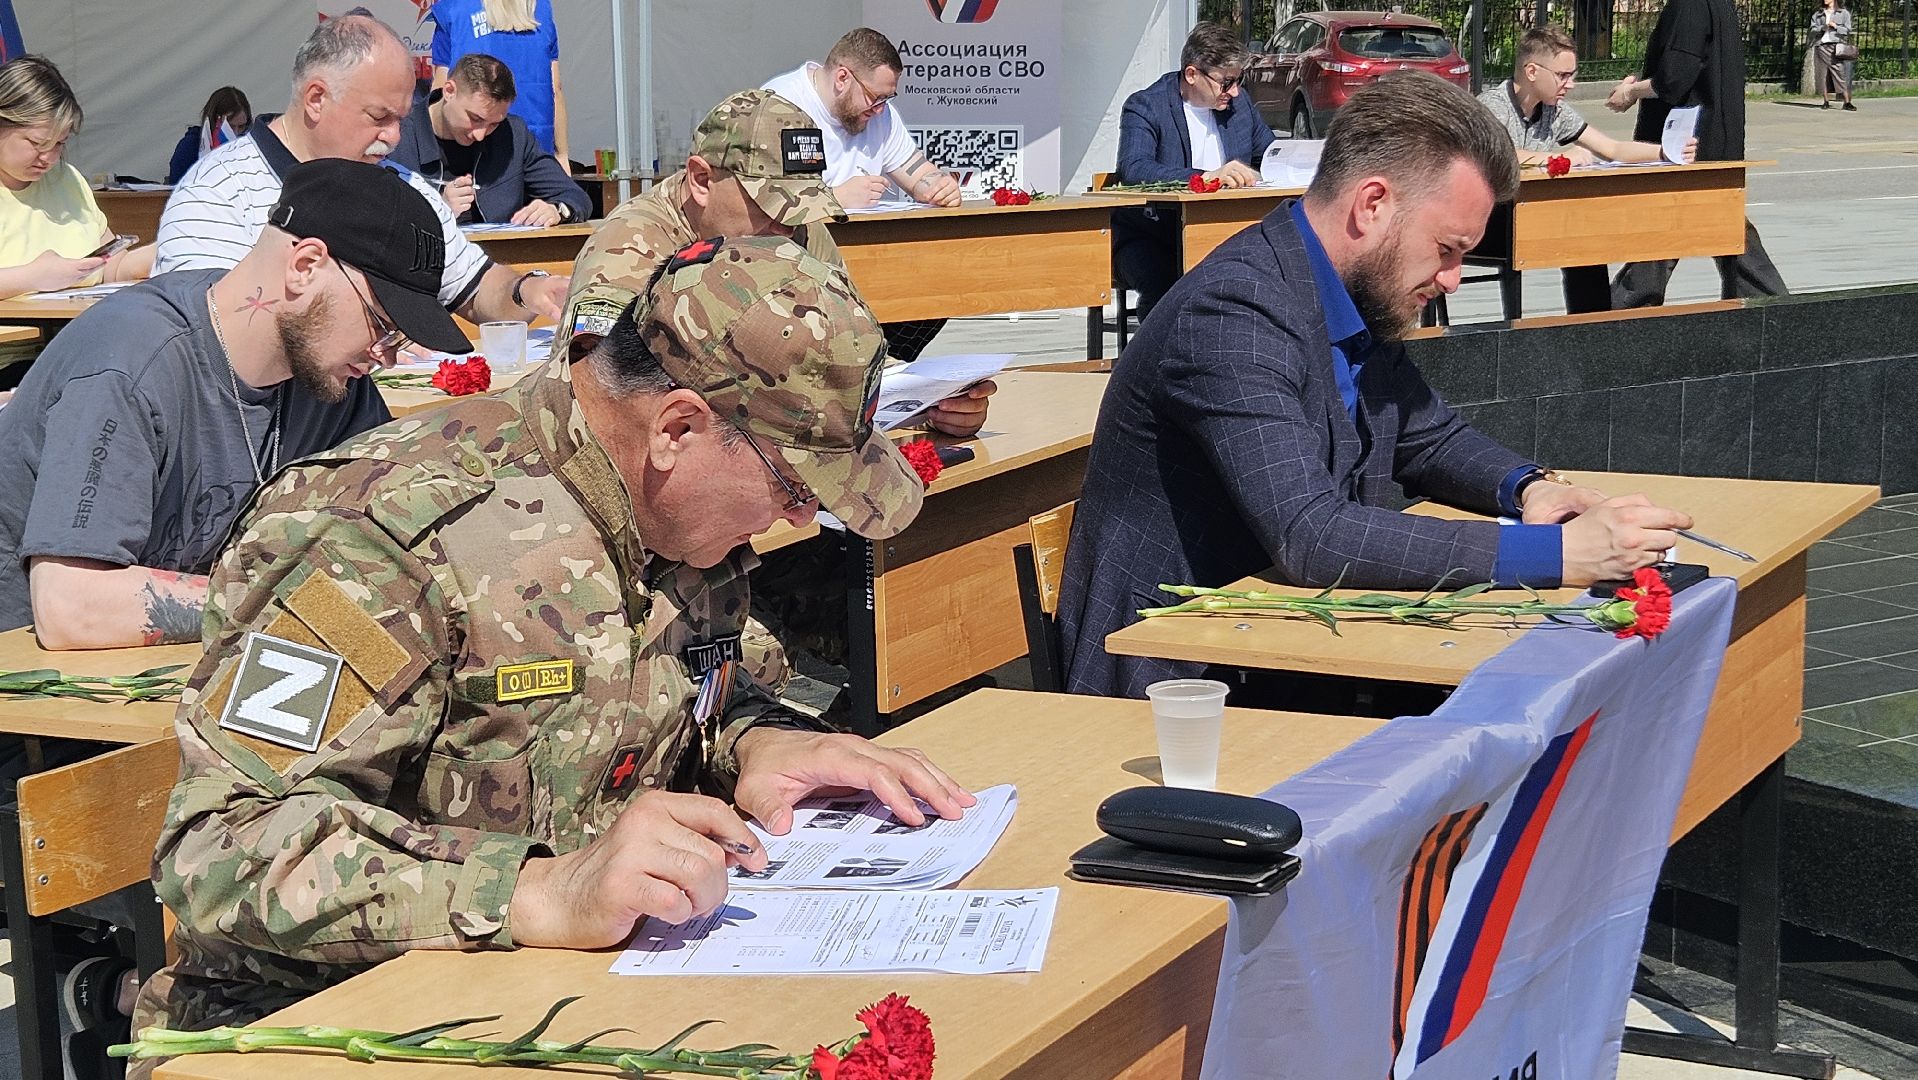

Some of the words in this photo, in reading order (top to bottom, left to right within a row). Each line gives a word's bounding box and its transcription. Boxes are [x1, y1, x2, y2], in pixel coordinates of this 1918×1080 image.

[898, 40, 1027, 59] Ассоциация
[902, 64, 991, 81] теранов
[999, 61, 1045, 78] СВО
[904, 85, 971, 94] Московской
[975, 85, 1020, 94] области
[936, 96, 998, 107] Жуковский
[540, 669, 567, 687] Rh+
[235, 648, 328, 736] Z
